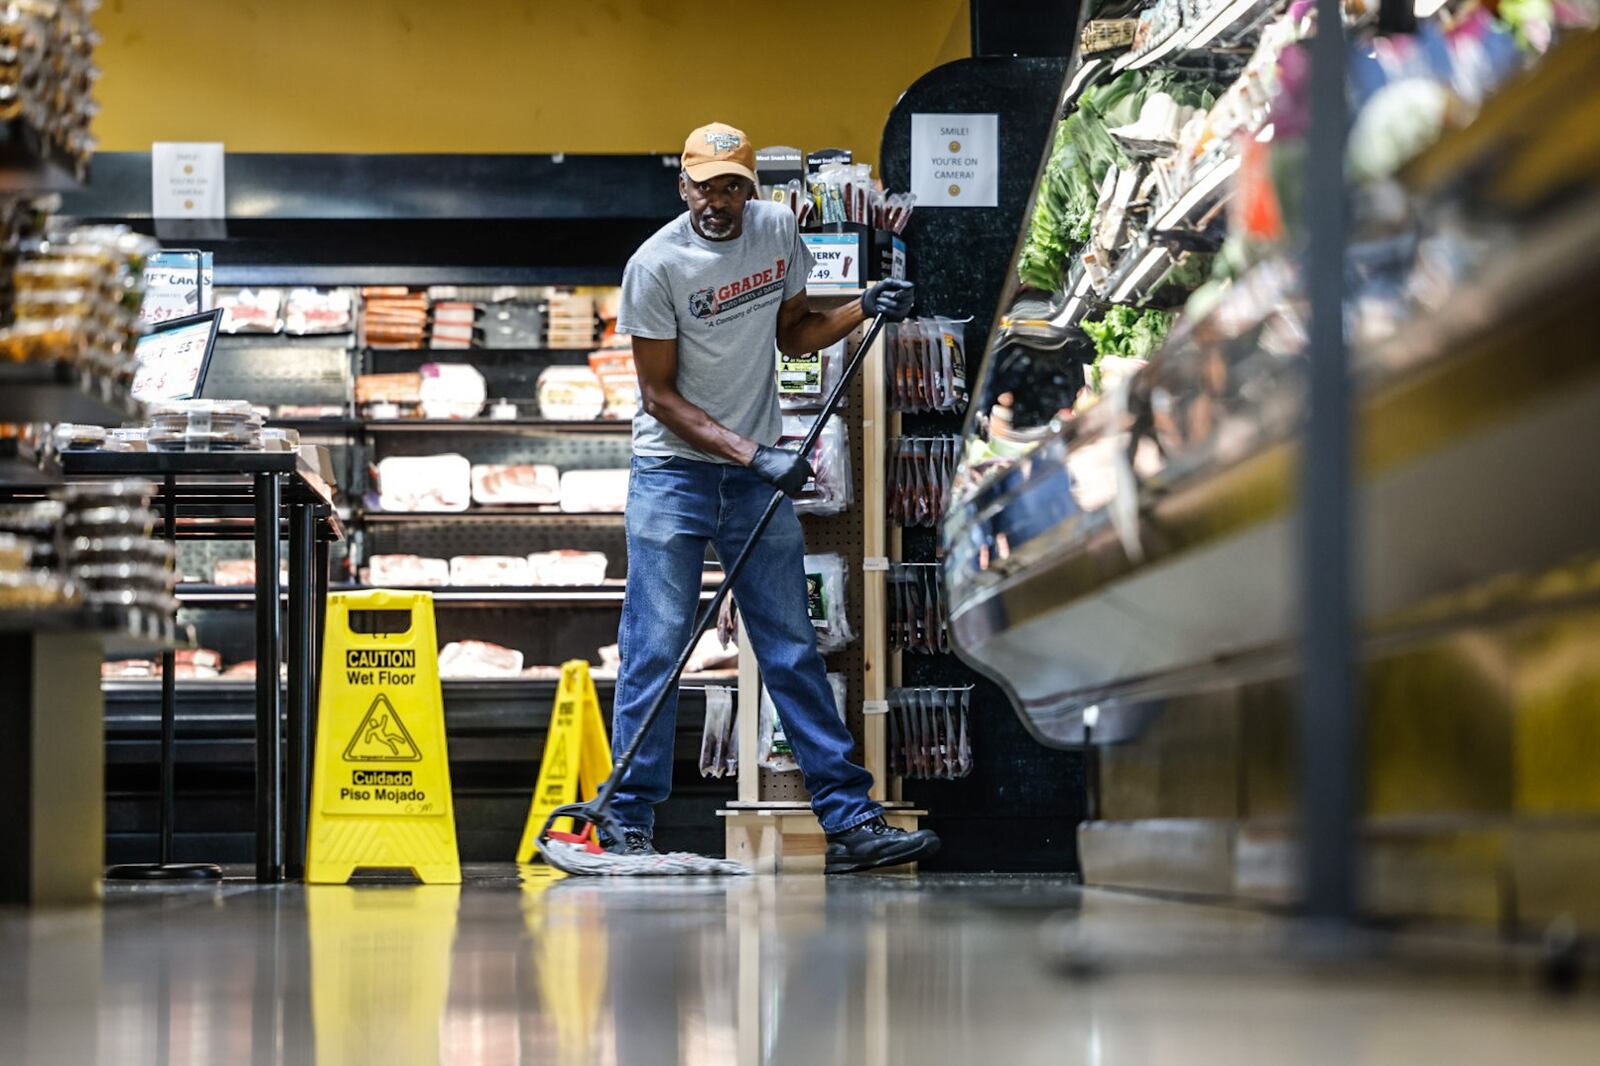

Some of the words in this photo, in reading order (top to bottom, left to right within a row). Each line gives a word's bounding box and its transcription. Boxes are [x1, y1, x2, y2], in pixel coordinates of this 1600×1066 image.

[940, 128, 969, 136] SMILE!
[931, 158, 962, 166] YOU'RE
[964, 158, 978, 166] ON
[934, 171, 974, 179] CAMERA!
[718, 269, 772, 301] GRADE
[775, 258, 785, 280] A
[715, 311, 745, 326] Company
[349, 651, 414, 667] CAUTION
[347, 671, 374, 685] Wet
[379, 671, 416, 685] Floor
[353, 772, 412, 785] Cuidado
[341, 788, 370, 801] Piso
[375, 788, 425, 804] Mojado
